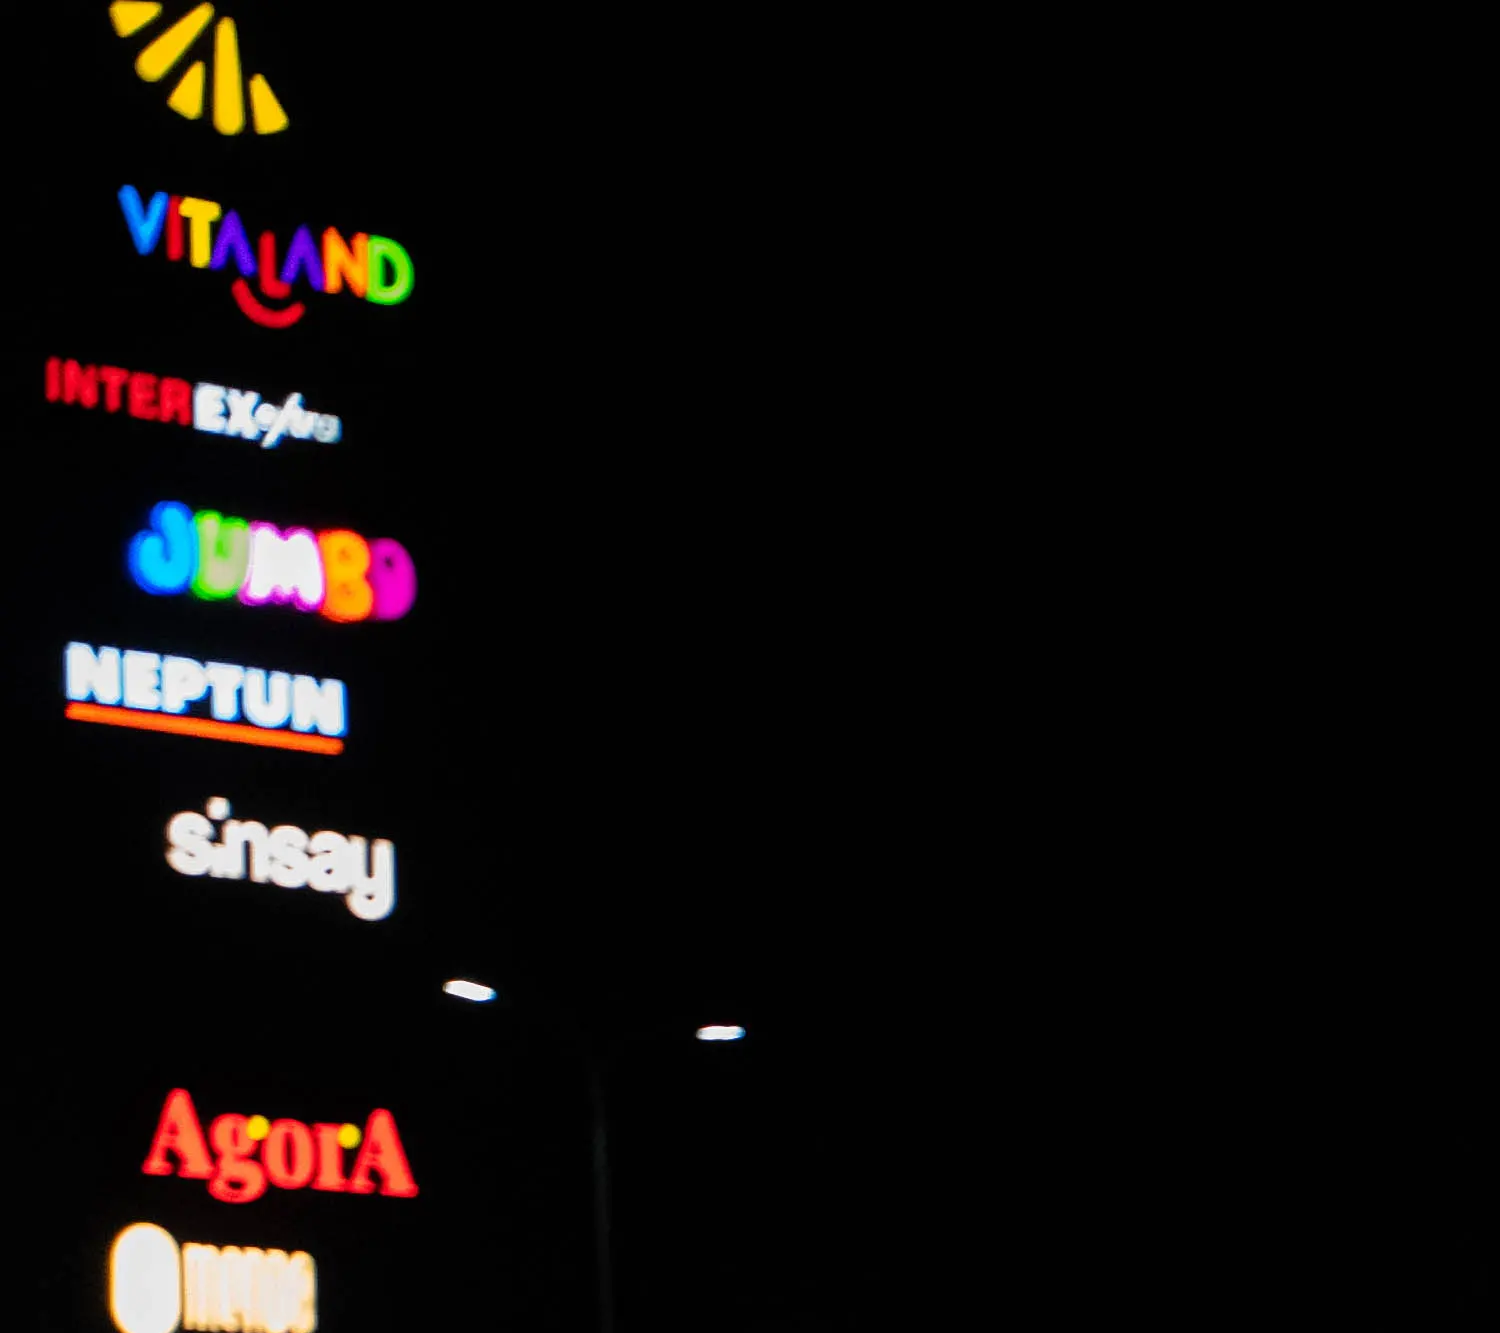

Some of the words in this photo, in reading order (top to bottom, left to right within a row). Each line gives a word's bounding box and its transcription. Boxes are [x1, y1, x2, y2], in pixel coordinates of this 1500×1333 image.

[118, 184, 415, 305] VITALAND
[128, 500, 418, 623] JUMBO
[65, 642, 347, 738] NEPTUN
[164, 796, 397, 921] sinsay
[141, 1087, 420, 1204] AgorA
